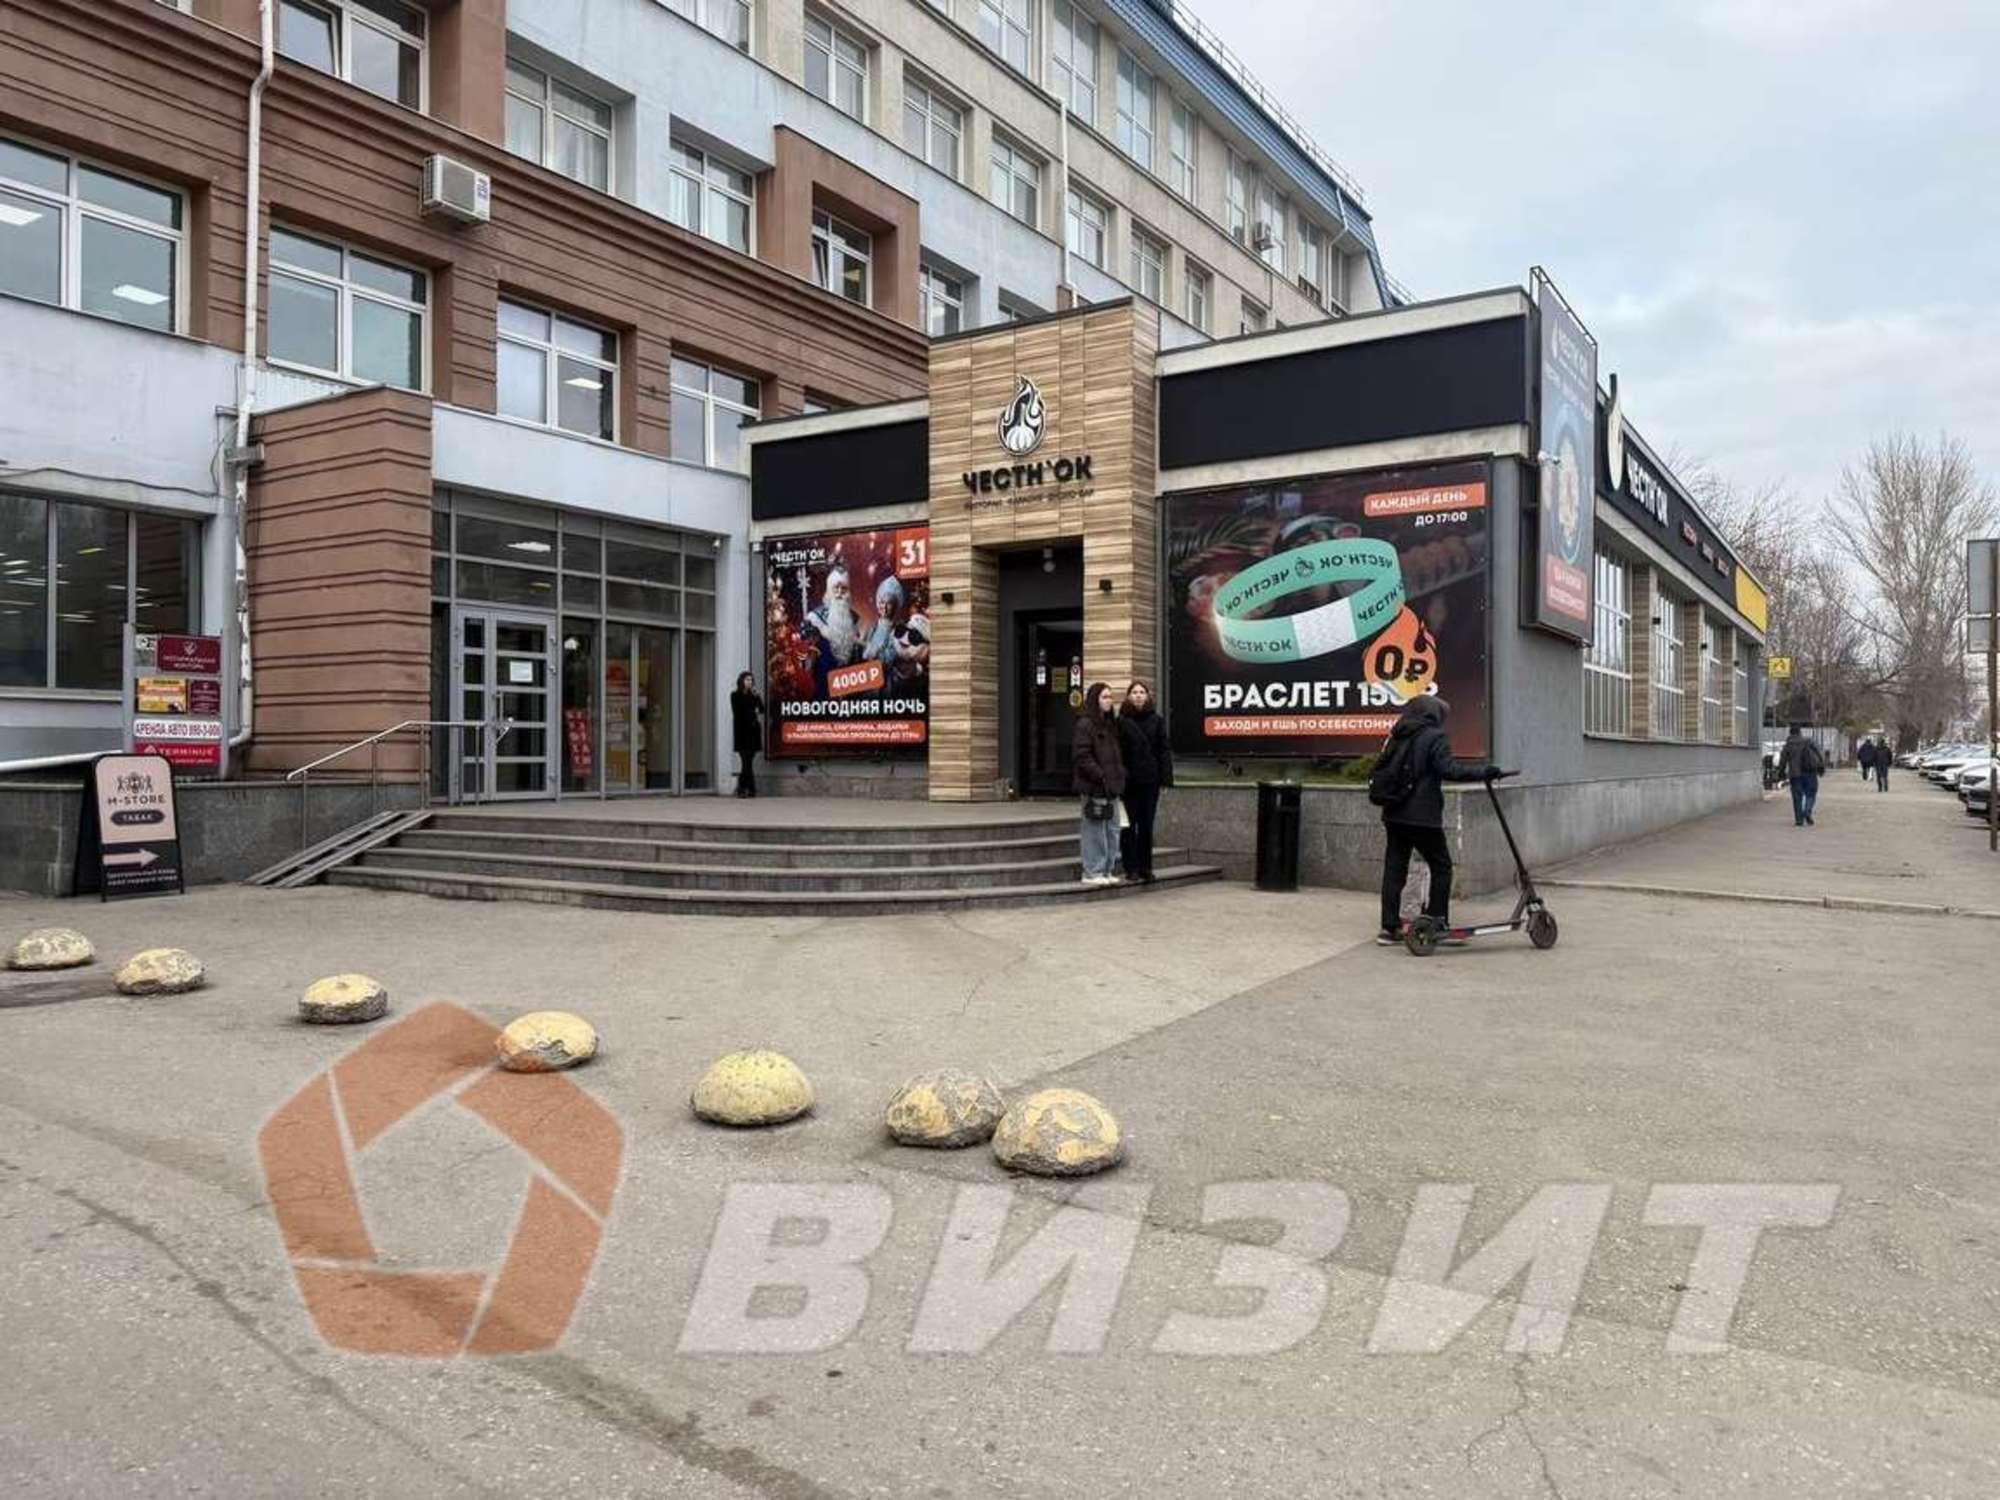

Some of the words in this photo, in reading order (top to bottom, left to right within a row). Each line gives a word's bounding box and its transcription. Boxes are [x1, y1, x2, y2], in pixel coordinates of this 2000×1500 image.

[1371, 496, 1430, 510] КАЖДЫЙ
[1432, 491, 1468, 505] ДЕНЬ
[1415, 514, 1435, 527] ДО
[1437, 511, 1468, 523] 17:00
[900, 539, 927, 566] 31
[831, 671, 868, 690] 4000
[1204, 680, 1350, 709] БРАСЛЕТ
[781, 701, 880, 717] НОВОГОДНЯЯ
[882, 699, 926, 715] НОЧЬ
[1213, 720, 1259, 731] ЗАХОДИ
[1261, 720, 1271, 730] И
[1272, 719, 1298, 730] ЕШЬ
[1300, 719, 1317, 730] ПО
